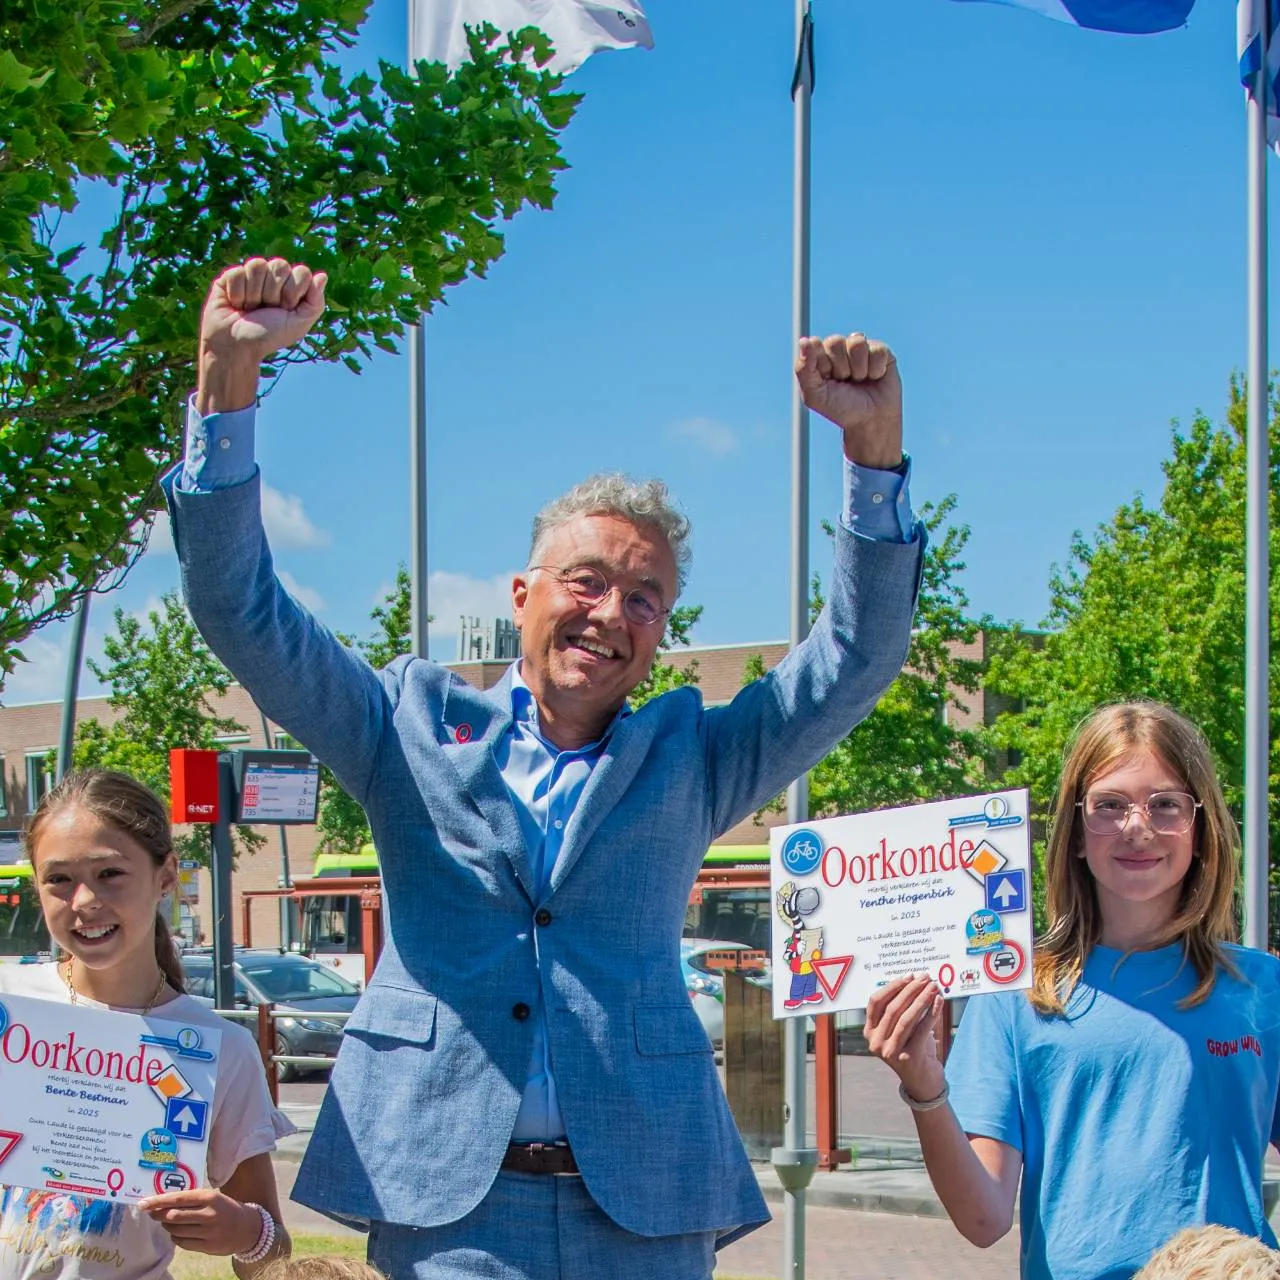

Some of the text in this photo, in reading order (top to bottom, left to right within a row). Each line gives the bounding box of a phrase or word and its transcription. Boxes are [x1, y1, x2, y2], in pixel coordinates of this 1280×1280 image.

[821, 828, 975, 888] Oorkonde
[860, 887, 955, 908] Yenthe Hogenbirk
[901, 910, 920, 919] 2025
[1, 1023, 163, 1086] Oorkonde
[1207, 1034, 1262, 1057] GROW WILD
[46, 1085, 128, 1105] Bente Bestman
[78, 1108, 99, 1117] 2025
